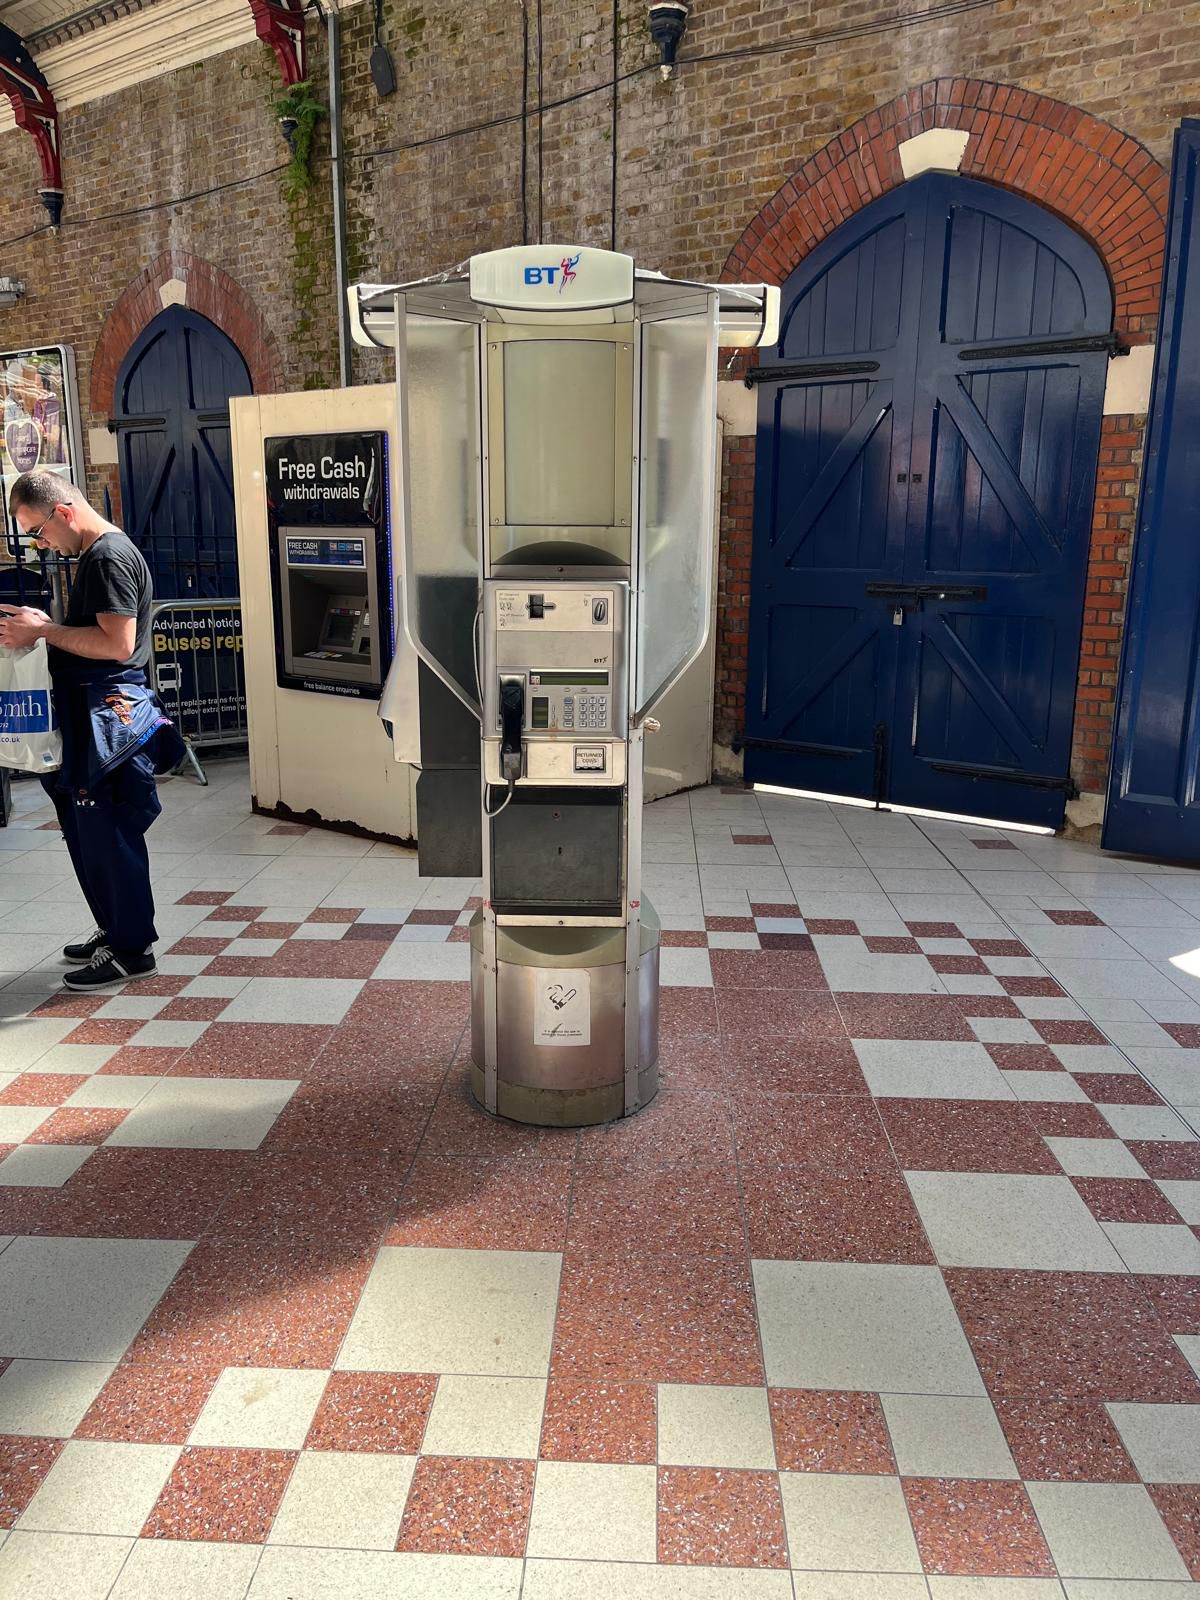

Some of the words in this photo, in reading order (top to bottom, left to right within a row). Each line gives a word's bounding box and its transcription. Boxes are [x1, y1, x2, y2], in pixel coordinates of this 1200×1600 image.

[524, 267, 560, 285] BT
[278, 457, 316, 480] Free
[320, 454, 366, 479] Cash
[283, 482, 360, 500] withdrawals
[288, 541, 302, 550] FREE
[302, 542, 318, 550] CASH
[153, 618, 206, 631] Advanced
[208, 617, 240, 629] Notice
[153, 633, 211, 652] Buses
[208, 697, 228, 706] trans
[221, 704, 236, 712] time
